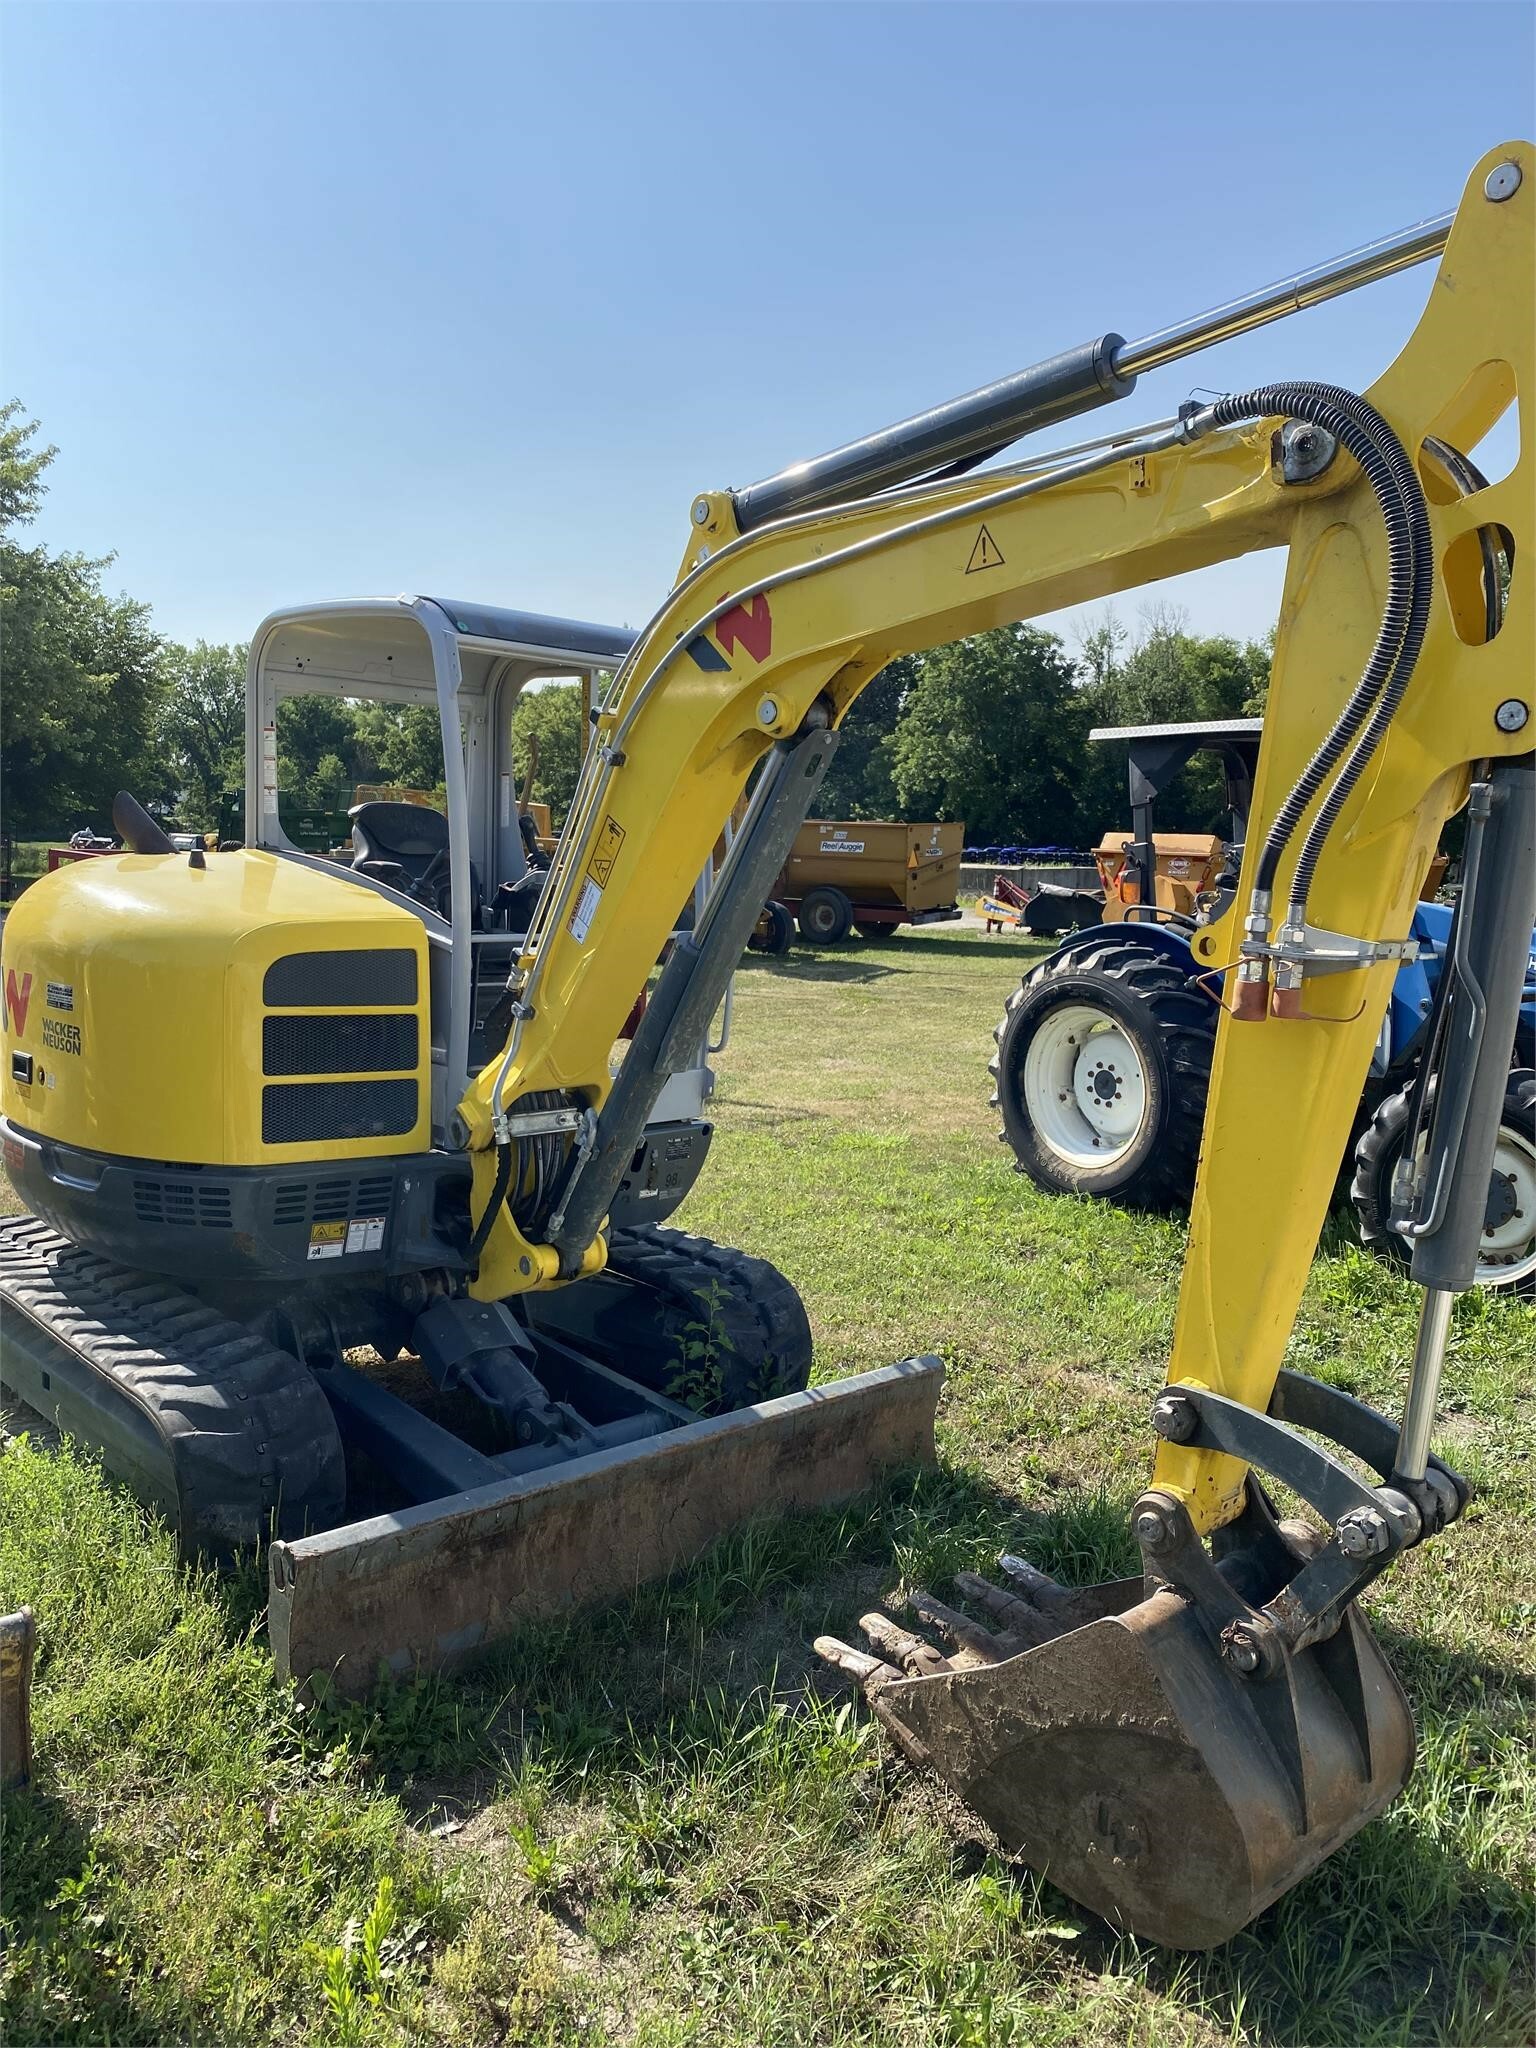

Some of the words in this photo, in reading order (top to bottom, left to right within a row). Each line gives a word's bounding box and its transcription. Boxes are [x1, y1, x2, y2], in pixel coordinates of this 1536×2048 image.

[821, 842, 839, 850] Reel
[839, 843, 863, 851] Auggie
[42, 1017, 81, 1041] WACKER
[42, 1033, 81, 1056] NEUSON
